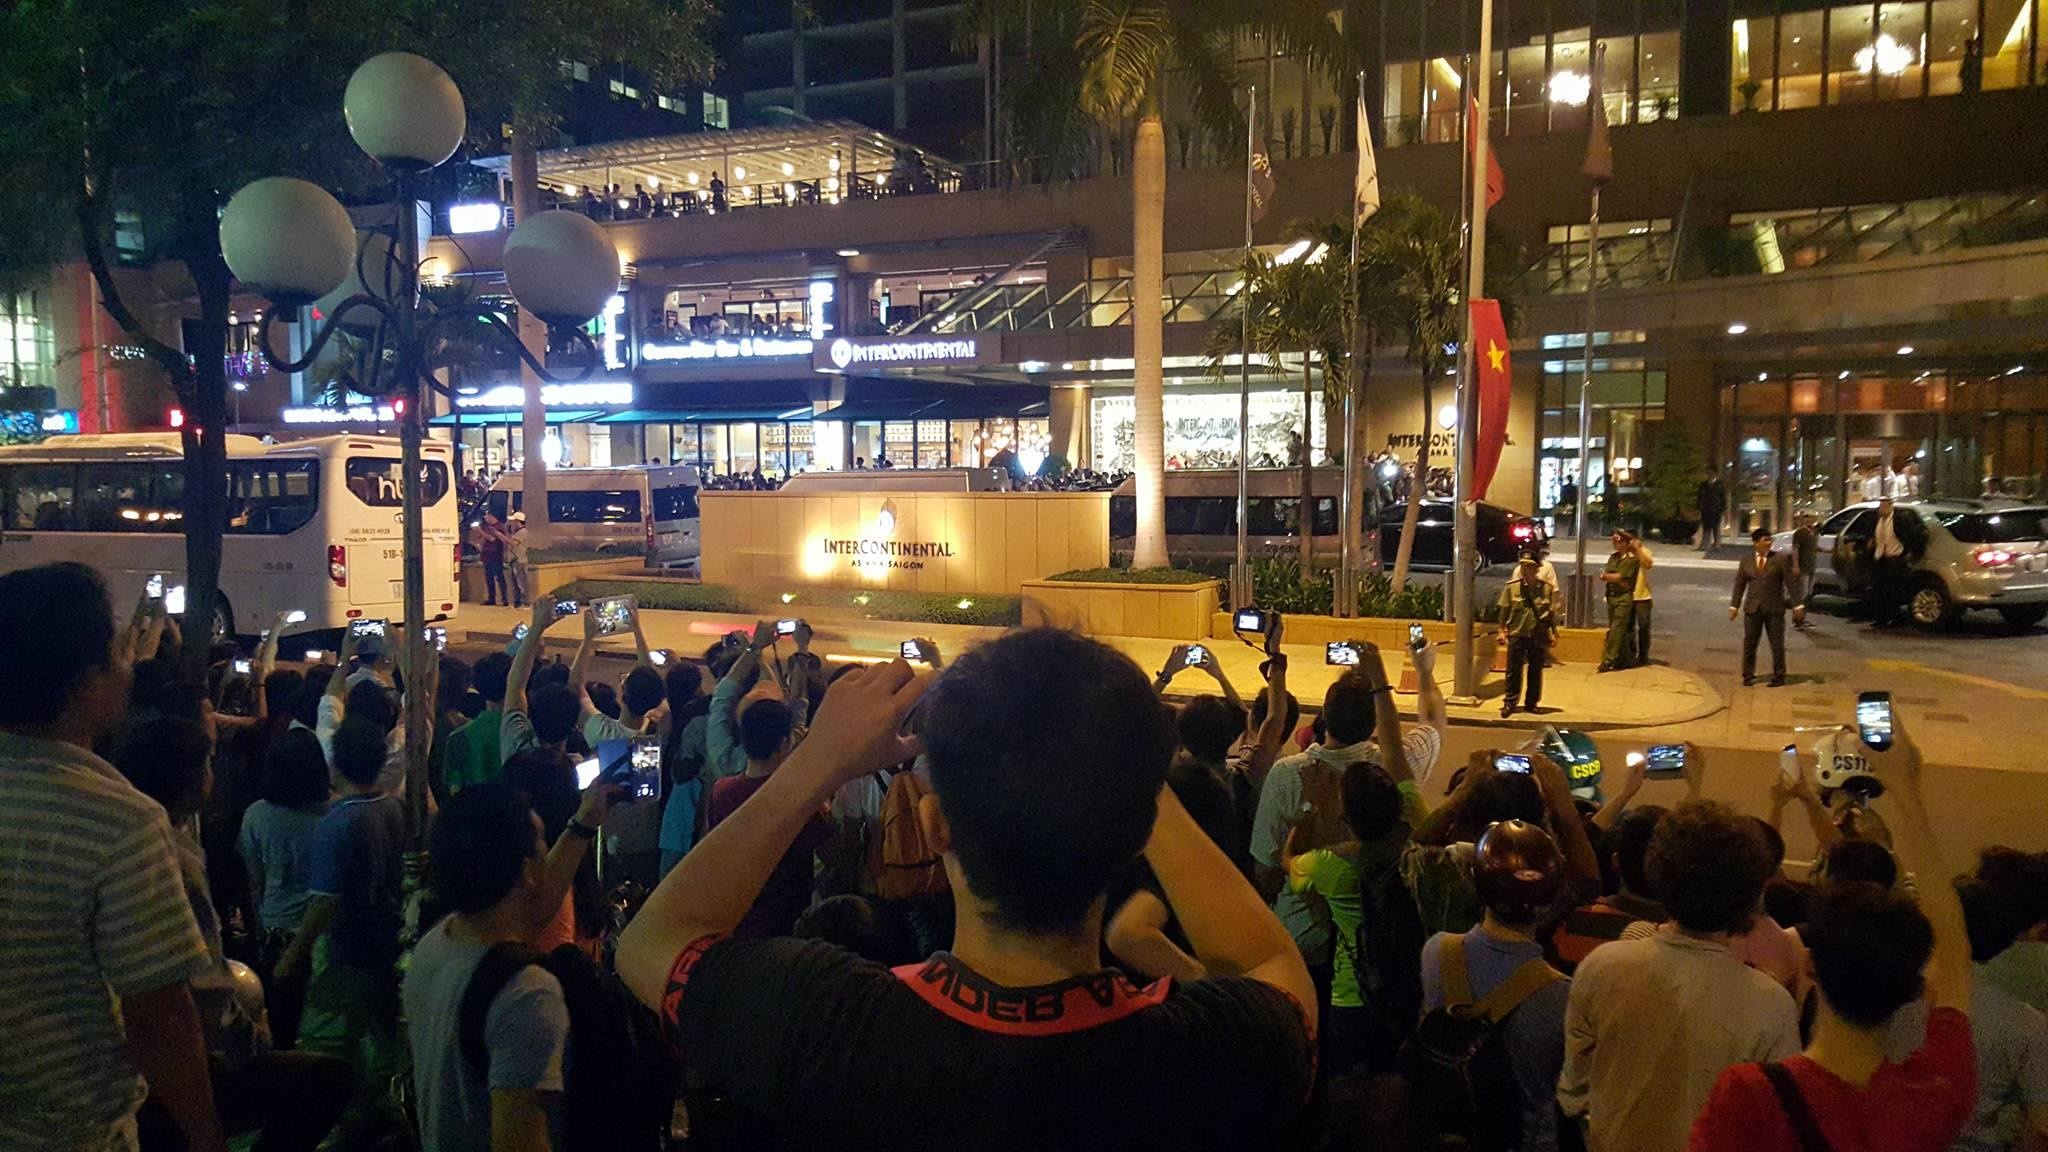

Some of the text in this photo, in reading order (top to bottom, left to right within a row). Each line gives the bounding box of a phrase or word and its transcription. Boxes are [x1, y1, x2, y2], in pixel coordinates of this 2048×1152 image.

[852, 341, 976, 363] INTERCONTINENTAL
[824, 538, 955, 558] INTERCONTINENTAL
[888, 560, 924, 569] SAIGON
